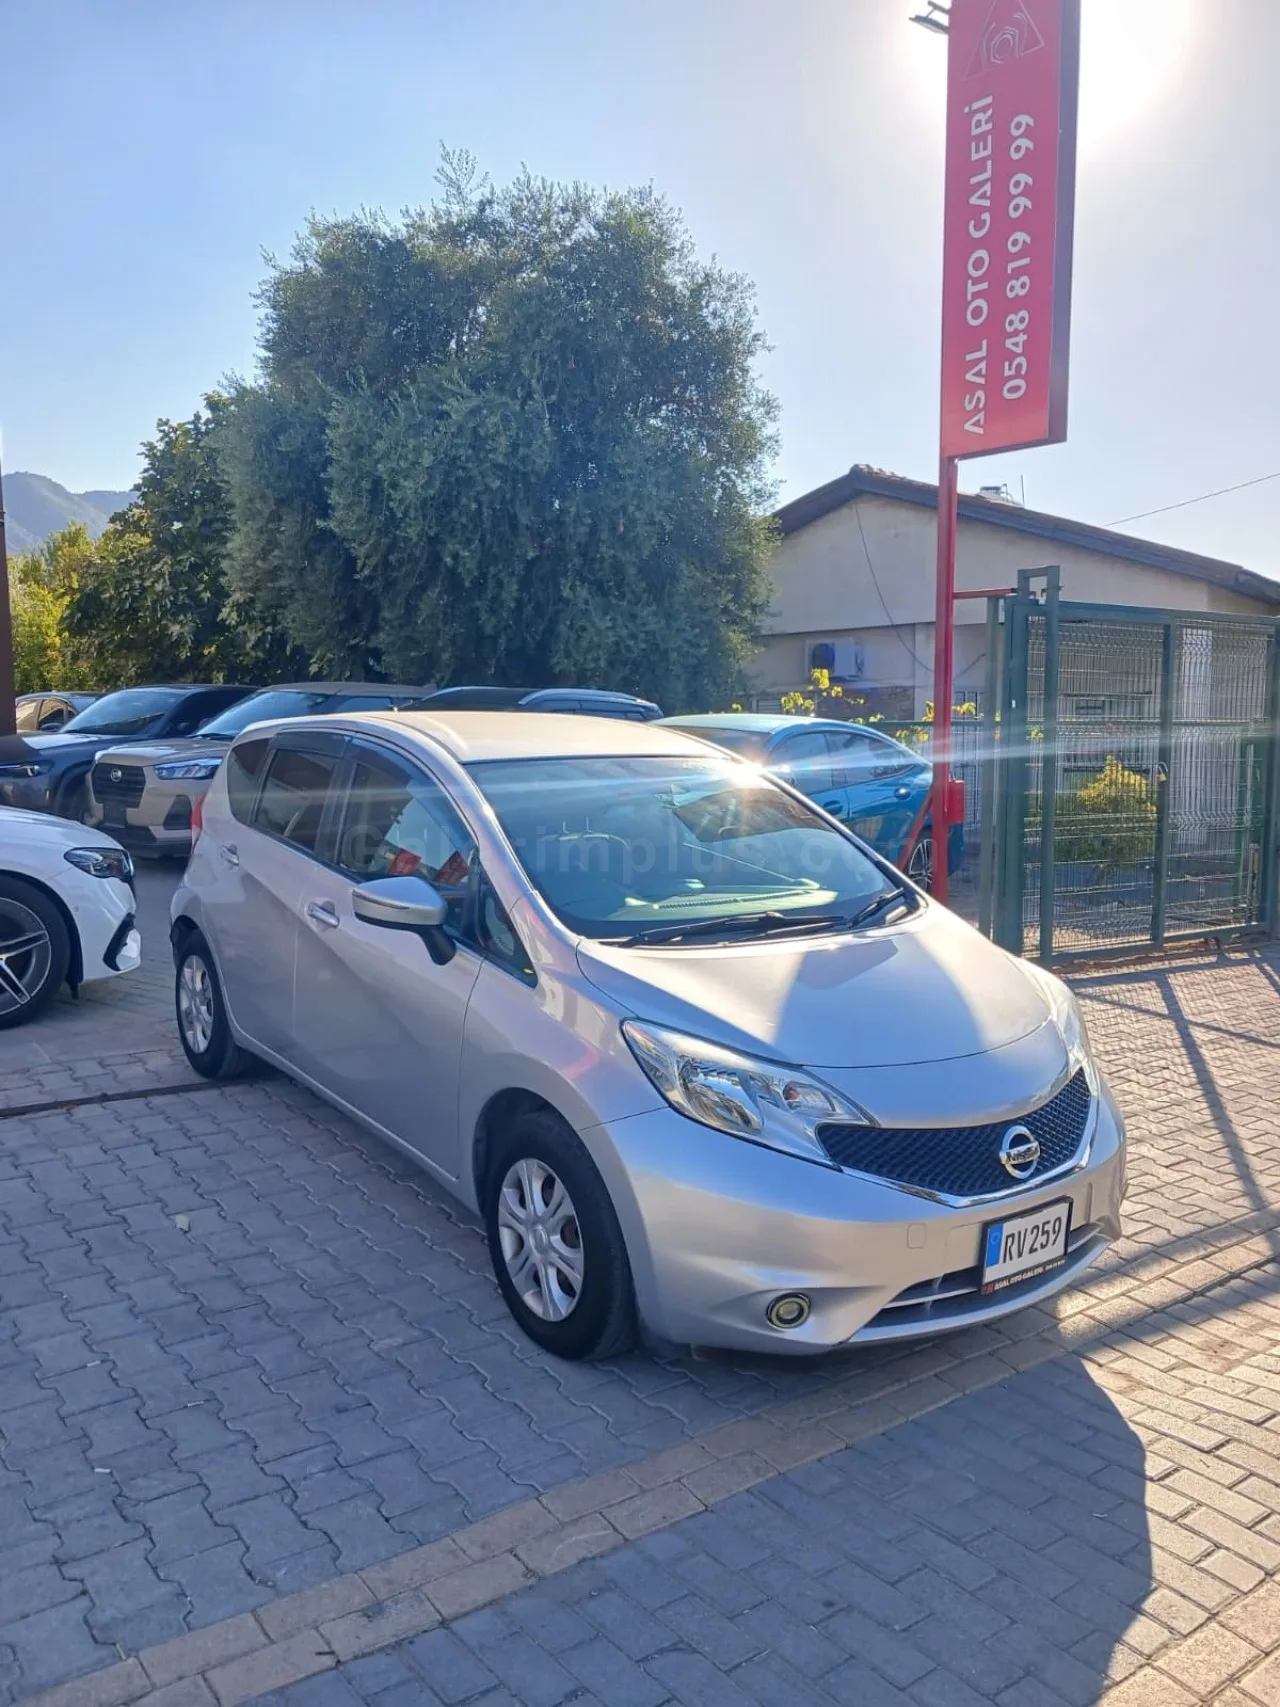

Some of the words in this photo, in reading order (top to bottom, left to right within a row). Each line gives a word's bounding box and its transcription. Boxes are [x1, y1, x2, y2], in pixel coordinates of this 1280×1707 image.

[1009, 114, 1035, 160] 99
[1008, 173, 1034, 219] 99
[966, 249, 990, 327] OTO
[1006, 231, 1031, 298] 819
[963, 339, 988, 434] ASAL
[1003, 309, 1030, 400] 0548
